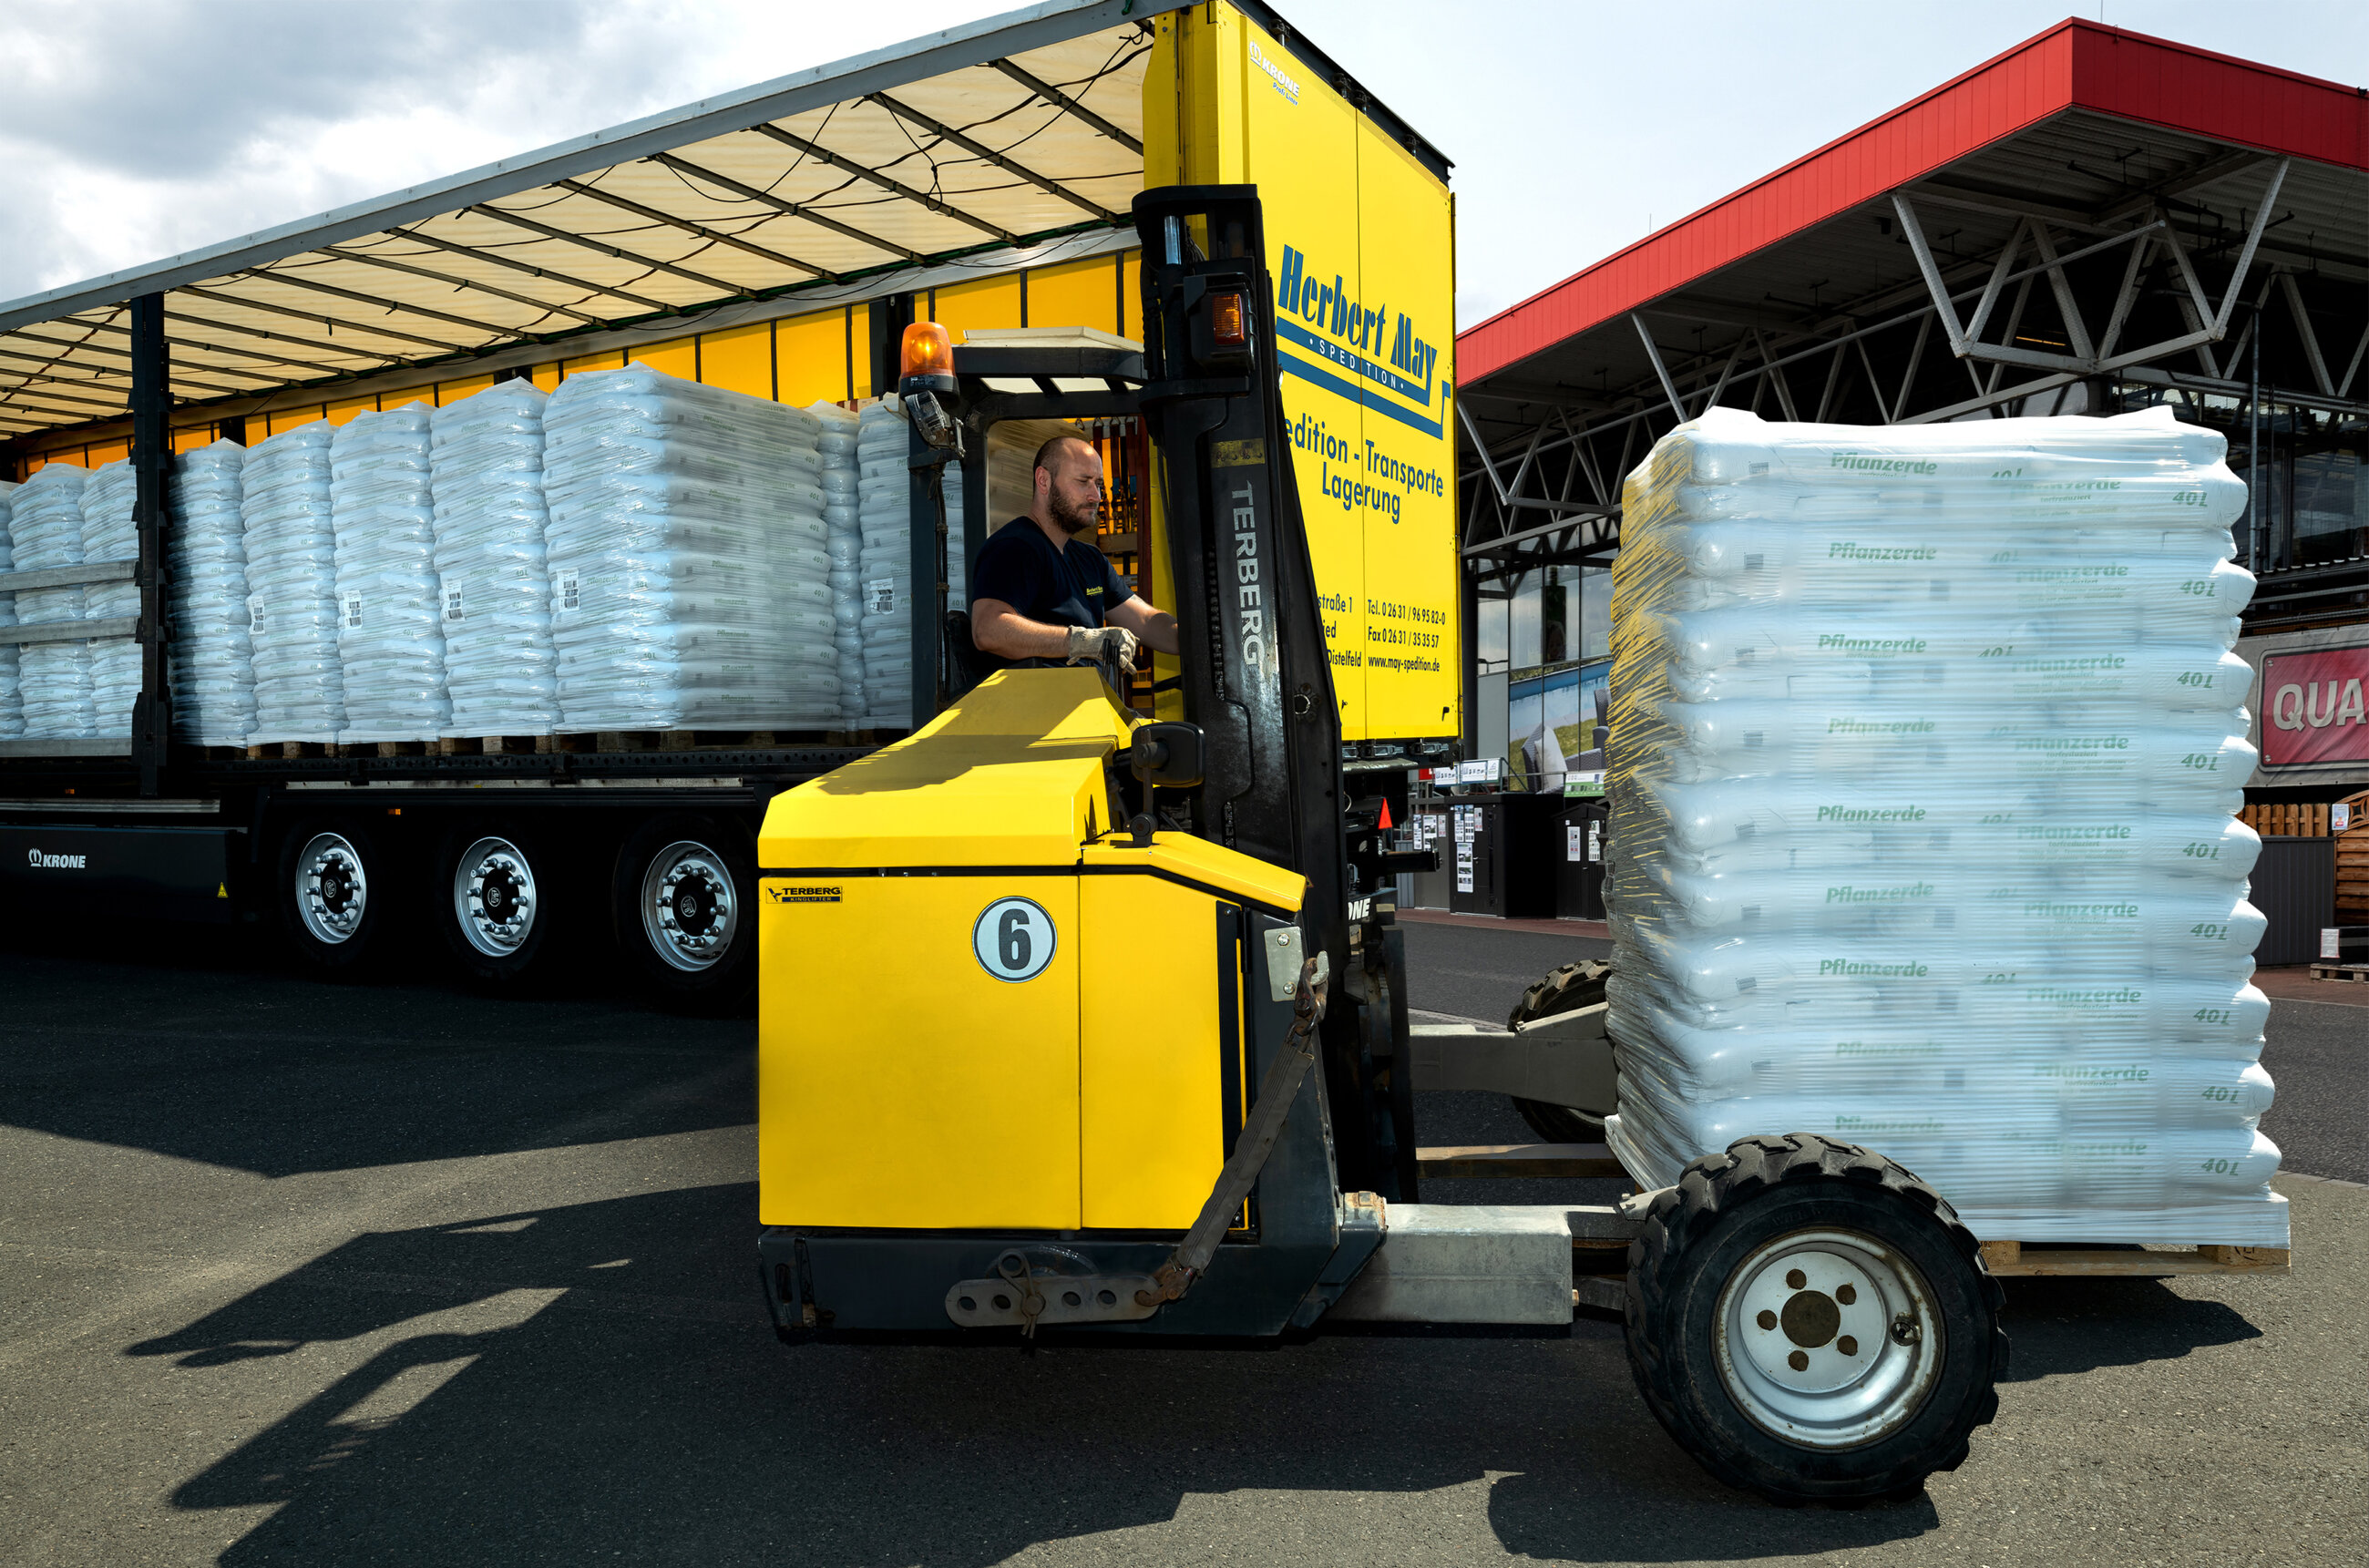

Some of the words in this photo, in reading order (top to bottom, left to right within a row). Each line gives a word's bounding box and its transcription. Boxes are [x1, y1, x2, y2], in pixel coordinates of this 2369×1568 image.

[1263, 57, 1300, 97] KRONE
[1273, 82, 1286, 97] Profi
[1286, 92, 1298, 106] Liner
[1278, 244, 1386, 357] Herbert
[1390, 313, 1438, 390] May
[1319, 340, 1396, 389] SPEDTION
[1366, 439, 1443, 497] Transporte
[1831, 452, 1937, 475] Pflanzerde
[1322, 461, 1400, 524] Lagerung
[1829, 542, 1936, 560] Pflanzerde
[1232, 480, 1266, 666] TERBERG
[1368, 600, 1380, 615] Tel.
[1382, 602, 1387, 616] 0
[1388, 603, 1397, 619] 26
[1398, 604, 1406, 619] 31
[1408, 606, 1411, 621] /
[1412, 607, 1420, 621] 96
[1421, 609, 1430, 623] 95
[1368, 626, 1381, 641] Fax
[1382, 628, 1387, 642] 0
[1388, 629, 1397, 644] 26
[1398, 630, 1406, 644] 31
[1408, 631, 1411, 646] /
[1412, 632, 1420, 646] 35
[1421, 633, 1430, 648] 35
[1431, 635, 1440, 648] 57
[1818, 634, 1926, 653] Pflanzerde
[1368, 656, 1440, 673] www.may-spedition.de
[2273, 678, 2367, 732] QUA
[1828, 717, 1935, 733] Pflanzerde
[1817, 804, 1925, 822] Pflanzerde
[2017, 824, 2131, 839] Pflanzerde
[43, 855, 86, 868] KRONE
[1826, 881, 1934, 904] Pflanzerde
[999, 908, 1031, 970] 6
[1820, 958, 1928, 977] Pflanzerde
